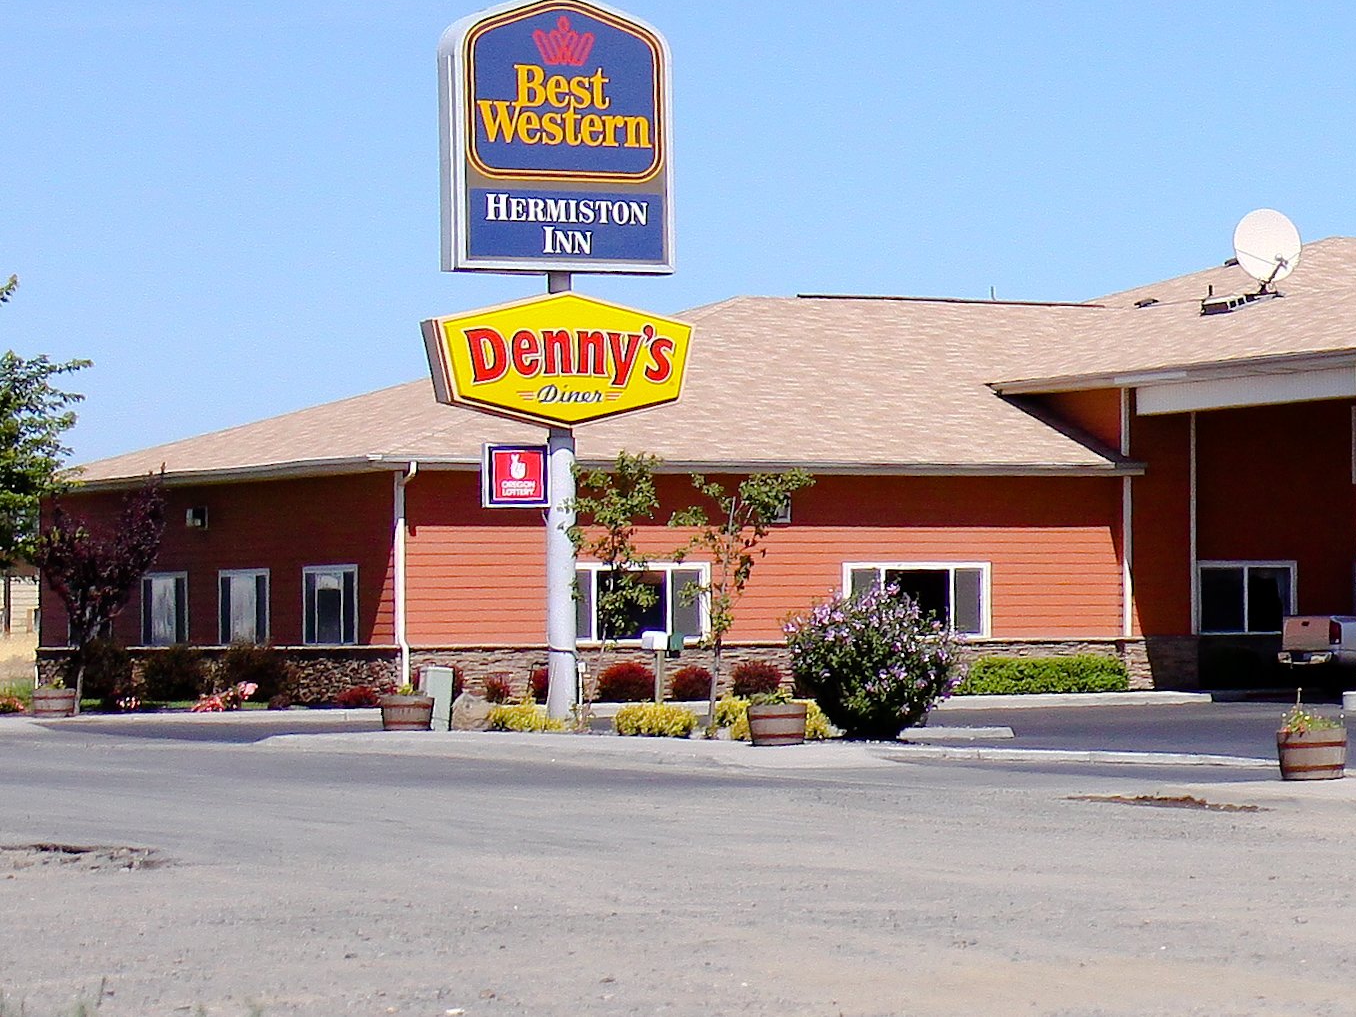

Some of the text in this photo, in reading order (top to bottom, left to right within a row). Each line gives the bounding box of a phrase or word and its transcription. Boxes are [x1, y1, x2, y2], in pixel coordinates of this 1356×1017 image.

[513, 63, 610, 110] Best
[476, 99, 652, 149] Western
[485, 193, 648, 225] HERMISTON
[542, 226, 592, 255] INN
[463, 324, 674, 387] Denny's
[536, 384, 603, 403] Diner
[501, 480, 536, 489] OREGON
[502, 488, 535, 496] LOTTERY
